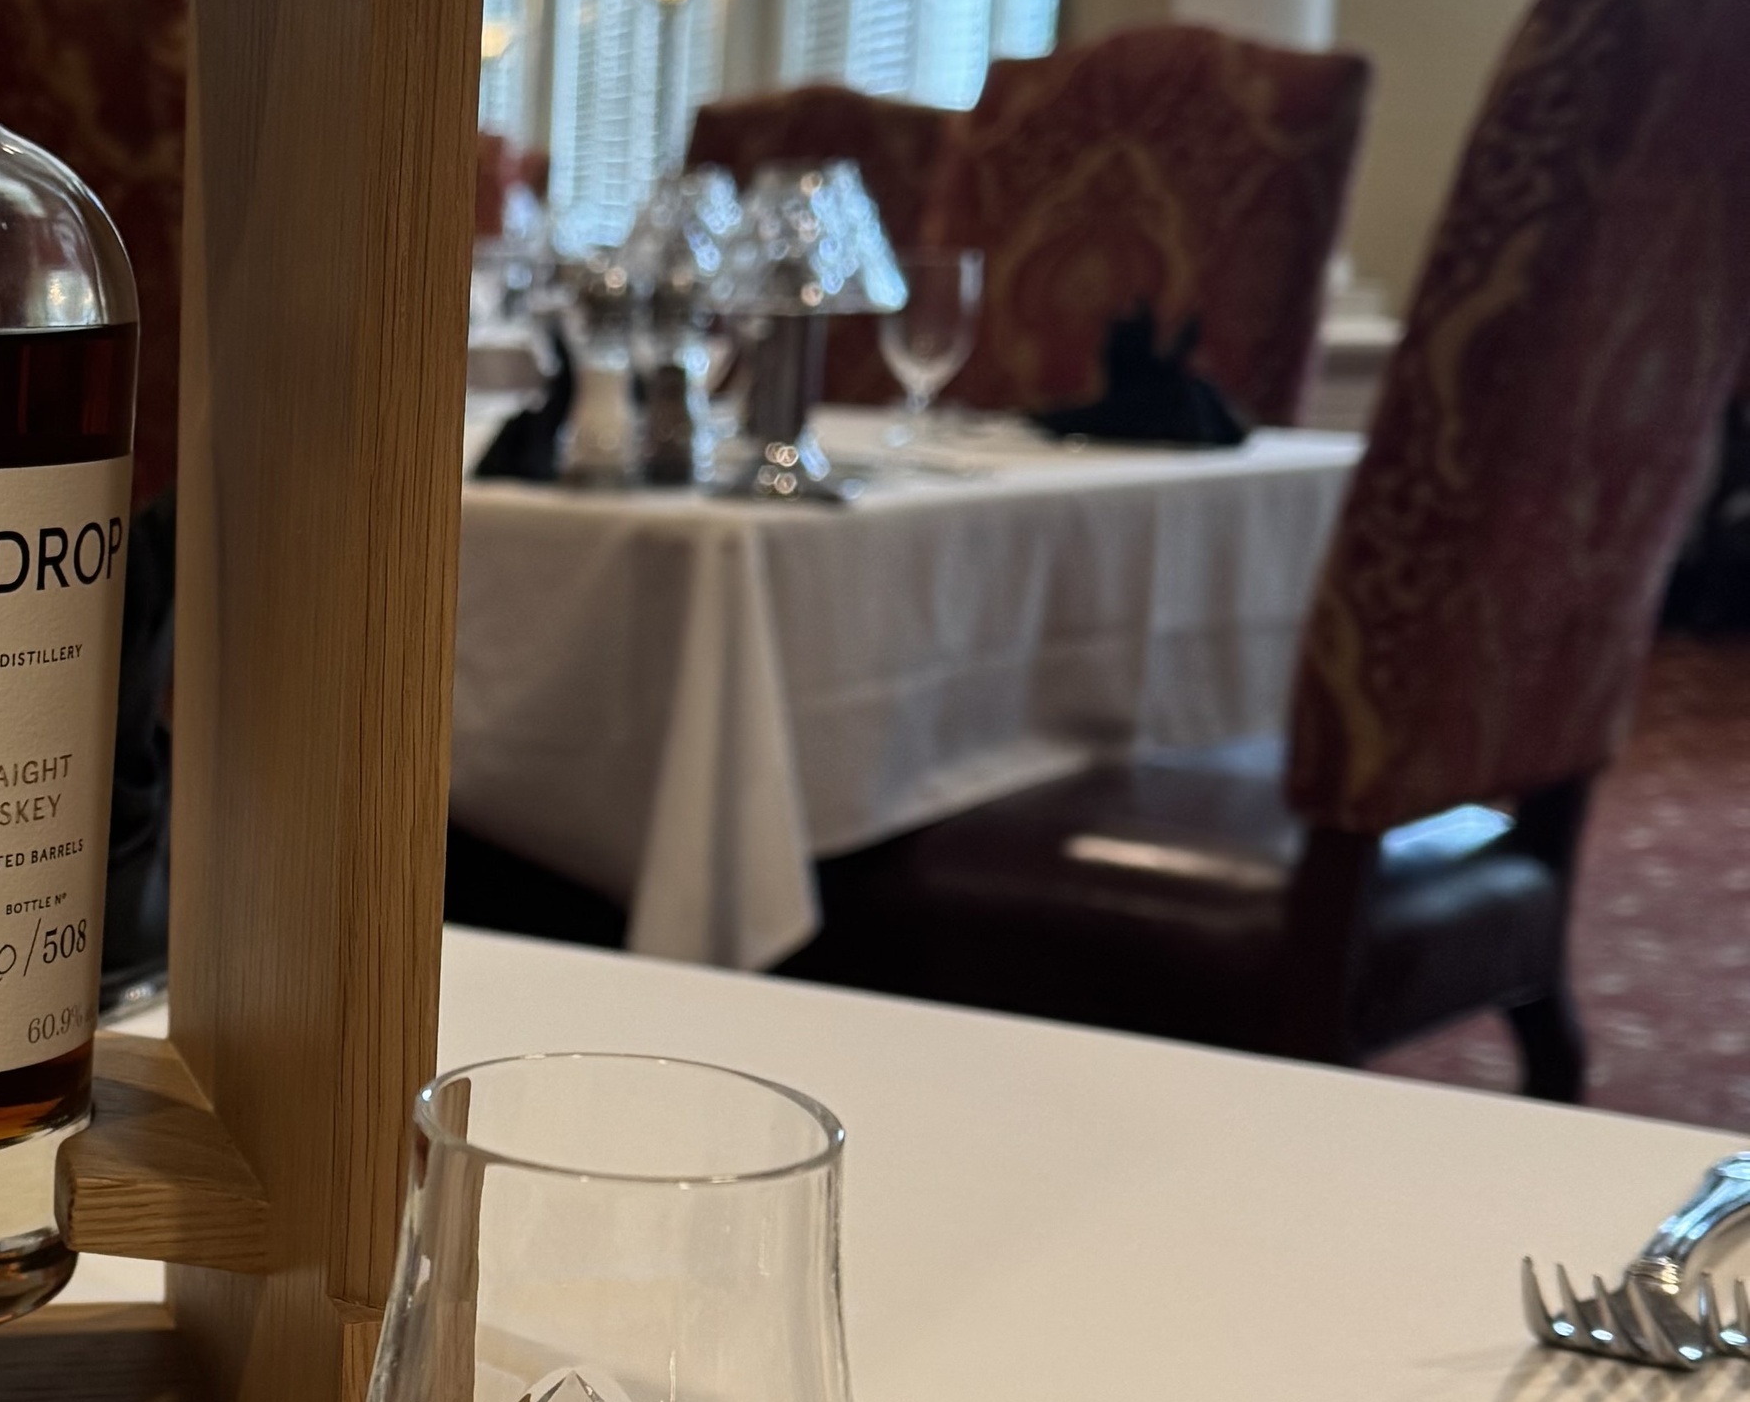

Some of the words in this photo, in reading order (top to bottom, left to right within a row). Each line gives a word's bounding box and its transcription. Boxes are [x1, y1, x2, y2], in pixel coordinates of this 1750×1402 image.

[0, 644, 83, 668] DISTILLERY
[30, 837, 84, 865] BARRELS
[5, 895, 52, 916] BOTTLE
